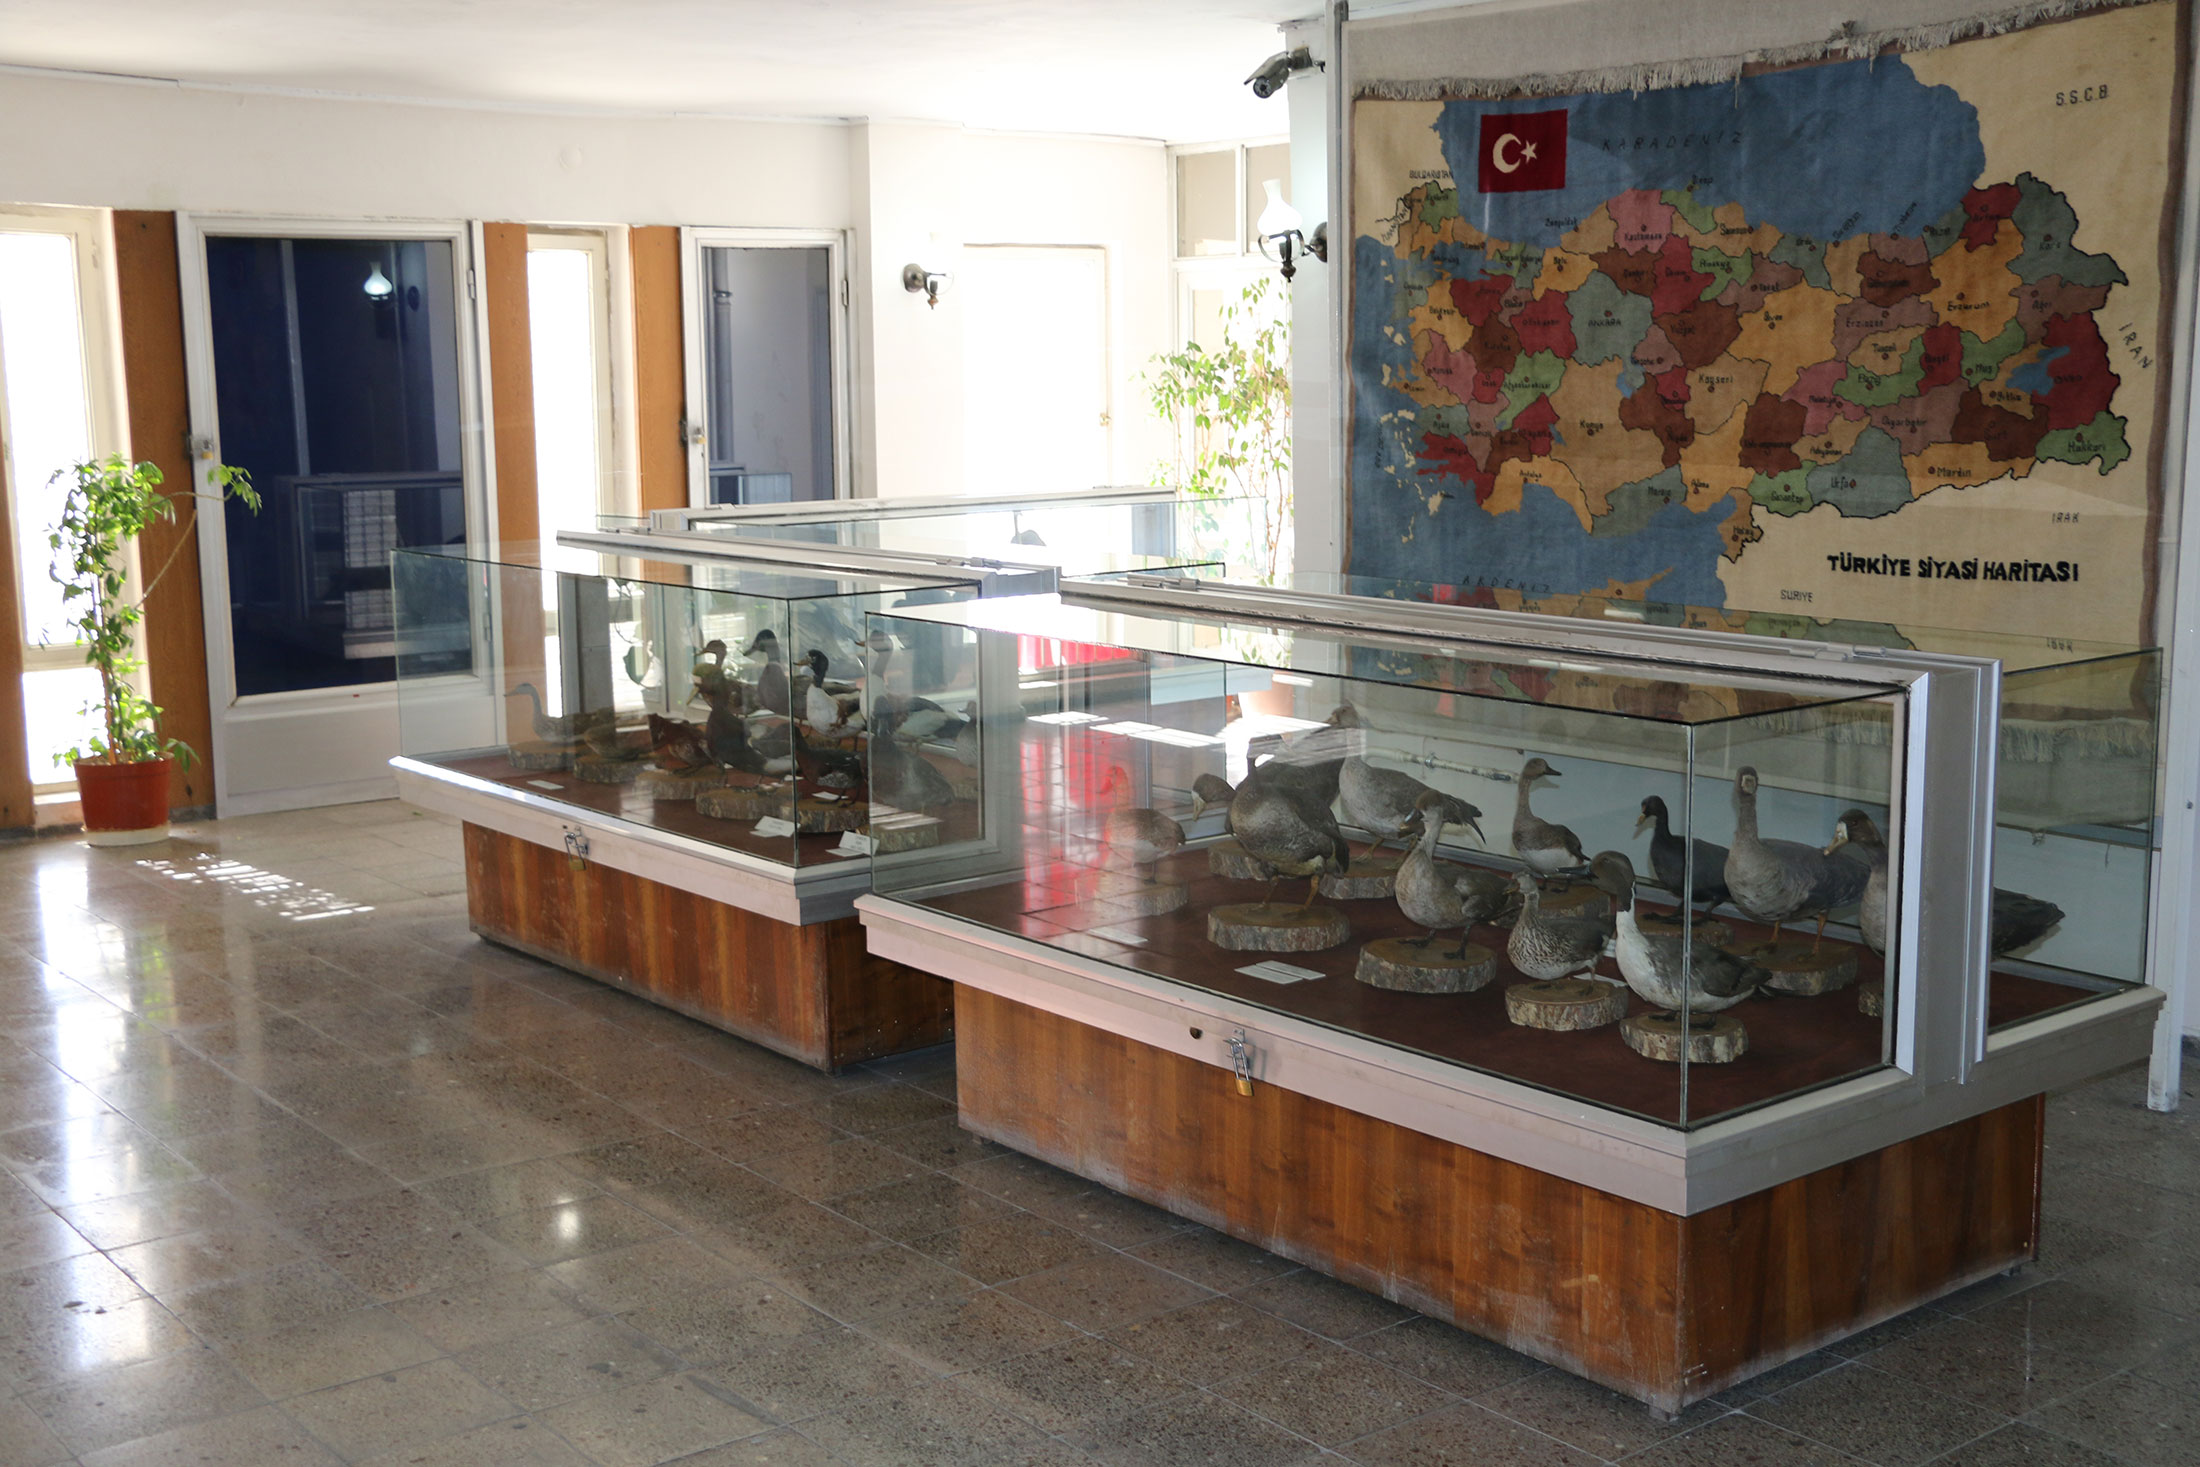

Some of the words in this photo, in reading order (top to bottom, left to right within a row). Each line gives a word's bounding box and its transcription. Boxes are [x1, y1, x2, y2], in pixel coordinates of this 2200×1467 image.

[1587, 317, 1622, 328] ANKARA
[1936, 466, 1973, 478] Mardin
[2051, 511, 2081, 525] IRAK
[1827, 551, 1912, 577] TÜRKİYE
[1917, 555, 1980, 580] SİYASİ
[1982, 558, 2080, 582] HARİTASI
